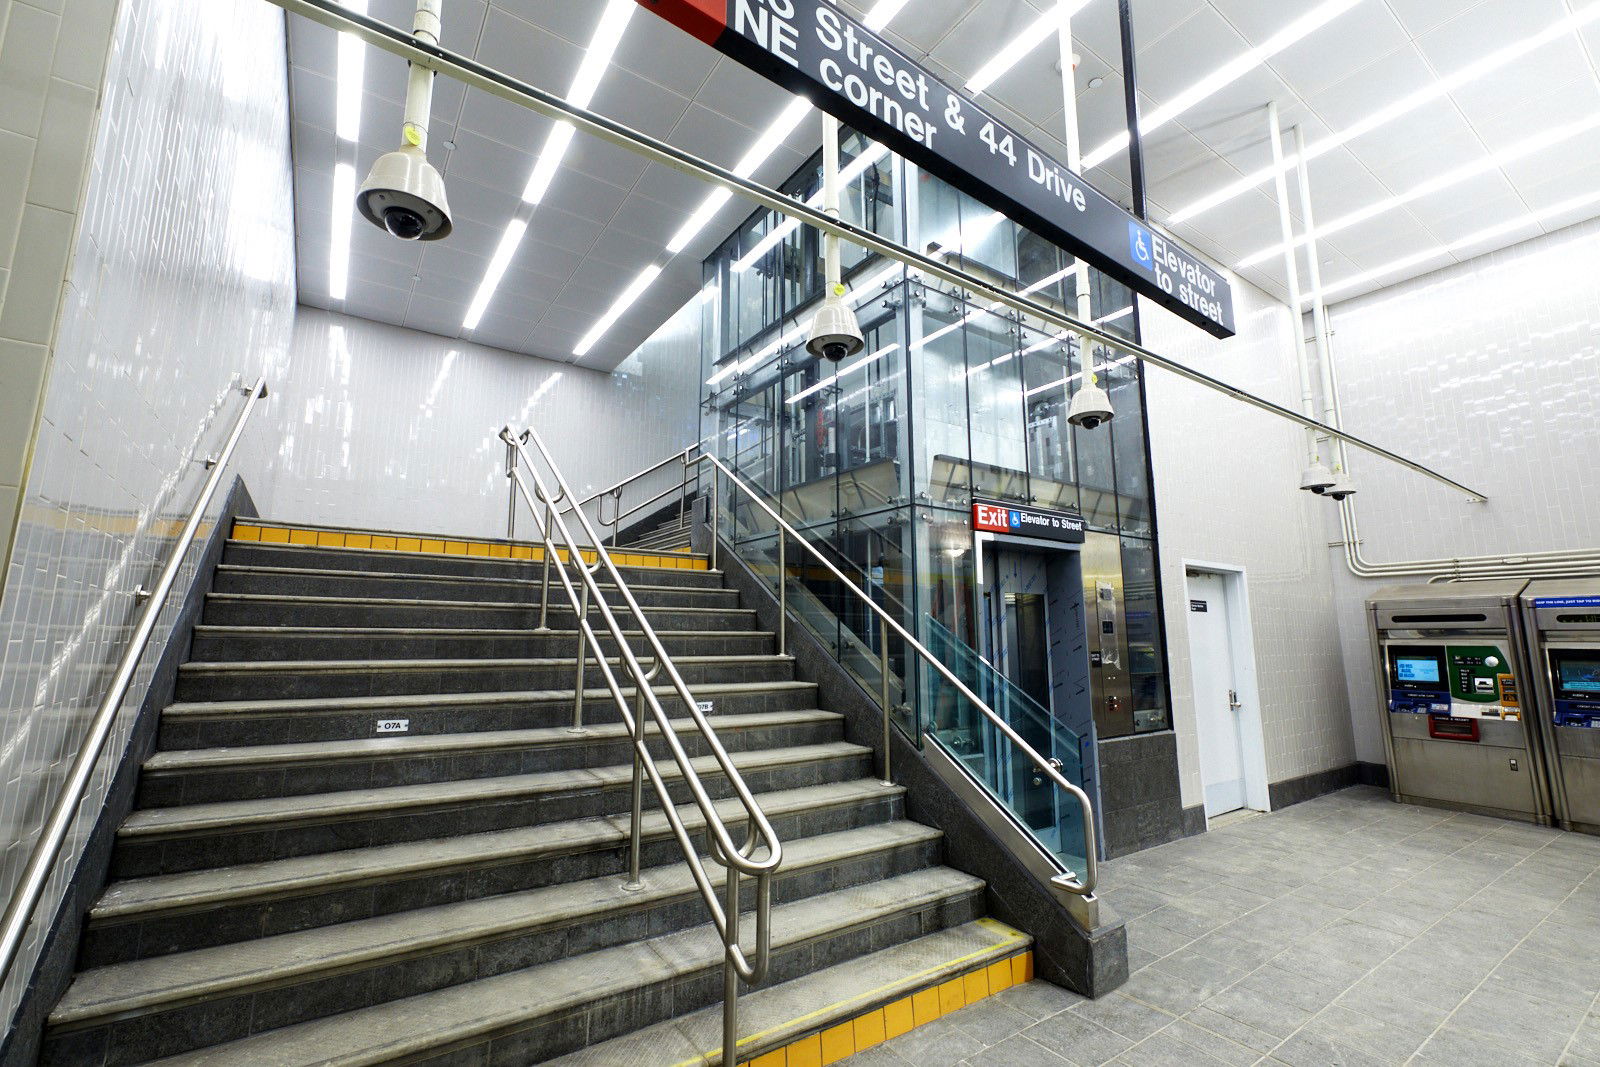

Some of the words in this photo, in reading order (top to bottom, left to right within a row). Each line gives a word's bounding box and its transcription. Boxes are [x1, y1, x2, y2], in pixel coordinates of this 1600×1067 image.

[735, 0, 799, 68] NE
[820, 58, 937, 149] corner
[815, 7, 929, 111] Street
[944, 94, 966, 135] &
[979, 122, 1018, 167] 44
[1027, 149, 1086, 212] Drive
[1151, 234, 1216, 297] Elevator
[1154, 262, 1173, 294] to
[1179, 282, 1224, 326] street
[977, 505, 1007, 527] Exit
[1020, 512, 1050, 526] Elevator
[1052, 517, 1060, 528] to
[1061, 519, 1082, 531] Street
